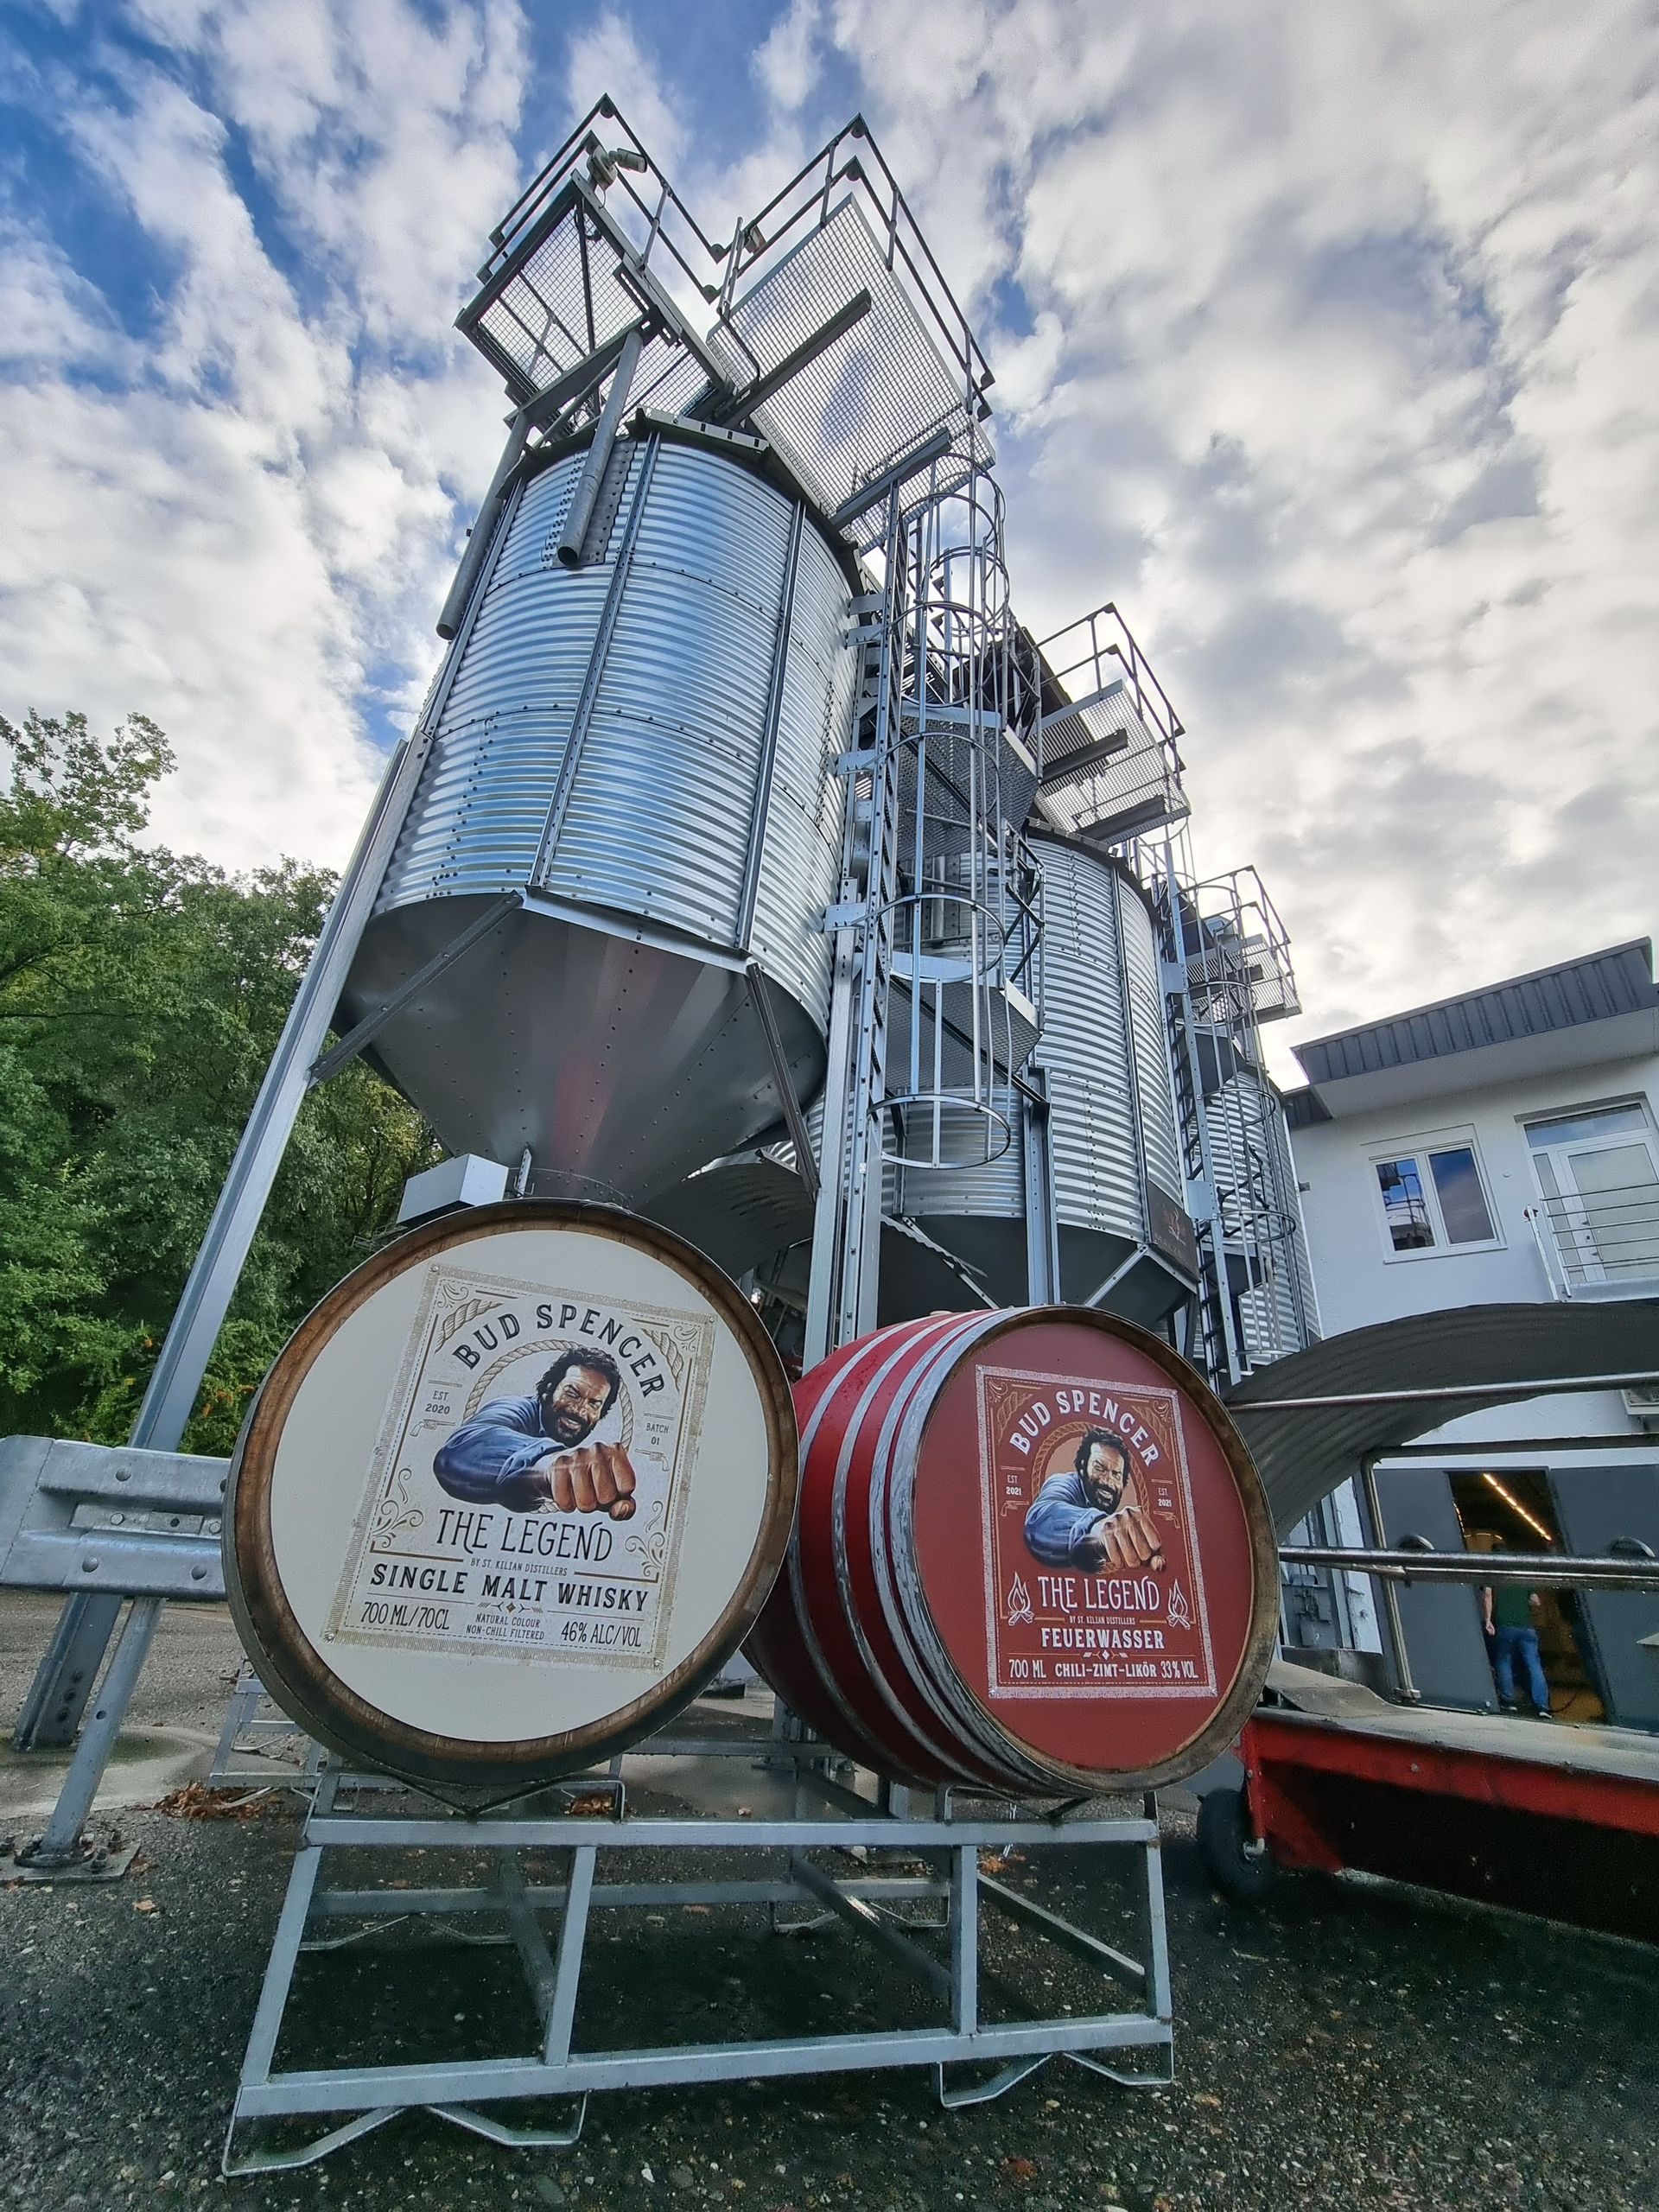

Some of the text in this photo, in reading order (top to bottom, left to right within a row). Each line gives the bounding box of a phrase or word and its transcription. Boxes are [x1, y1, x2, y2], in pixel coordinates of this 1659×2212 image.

[452, 1304, 664, 1398] BUD SPENCER
[425, 1403, 450, 1414] 2020
[646, 1422, 670, 1433] BATCH
[1009, 1389, 1160, 1466] BUD SPENCER
[1006, 1486, 1022, 1496] 2021
[1158, 1498, 1172, 1507] 2021
[436, 1509, 613, 1561] THE LEGEND
[470, 1558, 568, 1576] BY ST. KILIAN DISTILLERS
[370, 1563, 648, 1611] SINGLE MALT WHISKY
[1038, 1575, 1160, 1614] THE LEGEND
[360, 1601, 449, 1630] 700 ML/70CL
[475, 1613, 541, 1628] NATURAL COLOUR
[1069, 1615, 1077, 1624] BY
[1086, 1616, 1106, 1625] KILIAN
[1106, 1617, 1136, 1625] DISTILLERS
[466, 1624, 545, 1640] NON-CHILL FILTERED
[561, 1621, 642, 1648] 46% ALC/VOL
[1041, 1627, 1165, 1649] FEUERWASSER
[1009, 1659, 1030, 1678] 700
[1033, 1660, 1046, 1678] ML
[1055, 1661, 1157, 1678] CHILI-ZIMT-LIKÖR
[1160, 1660, 1180, 1678] 33%
